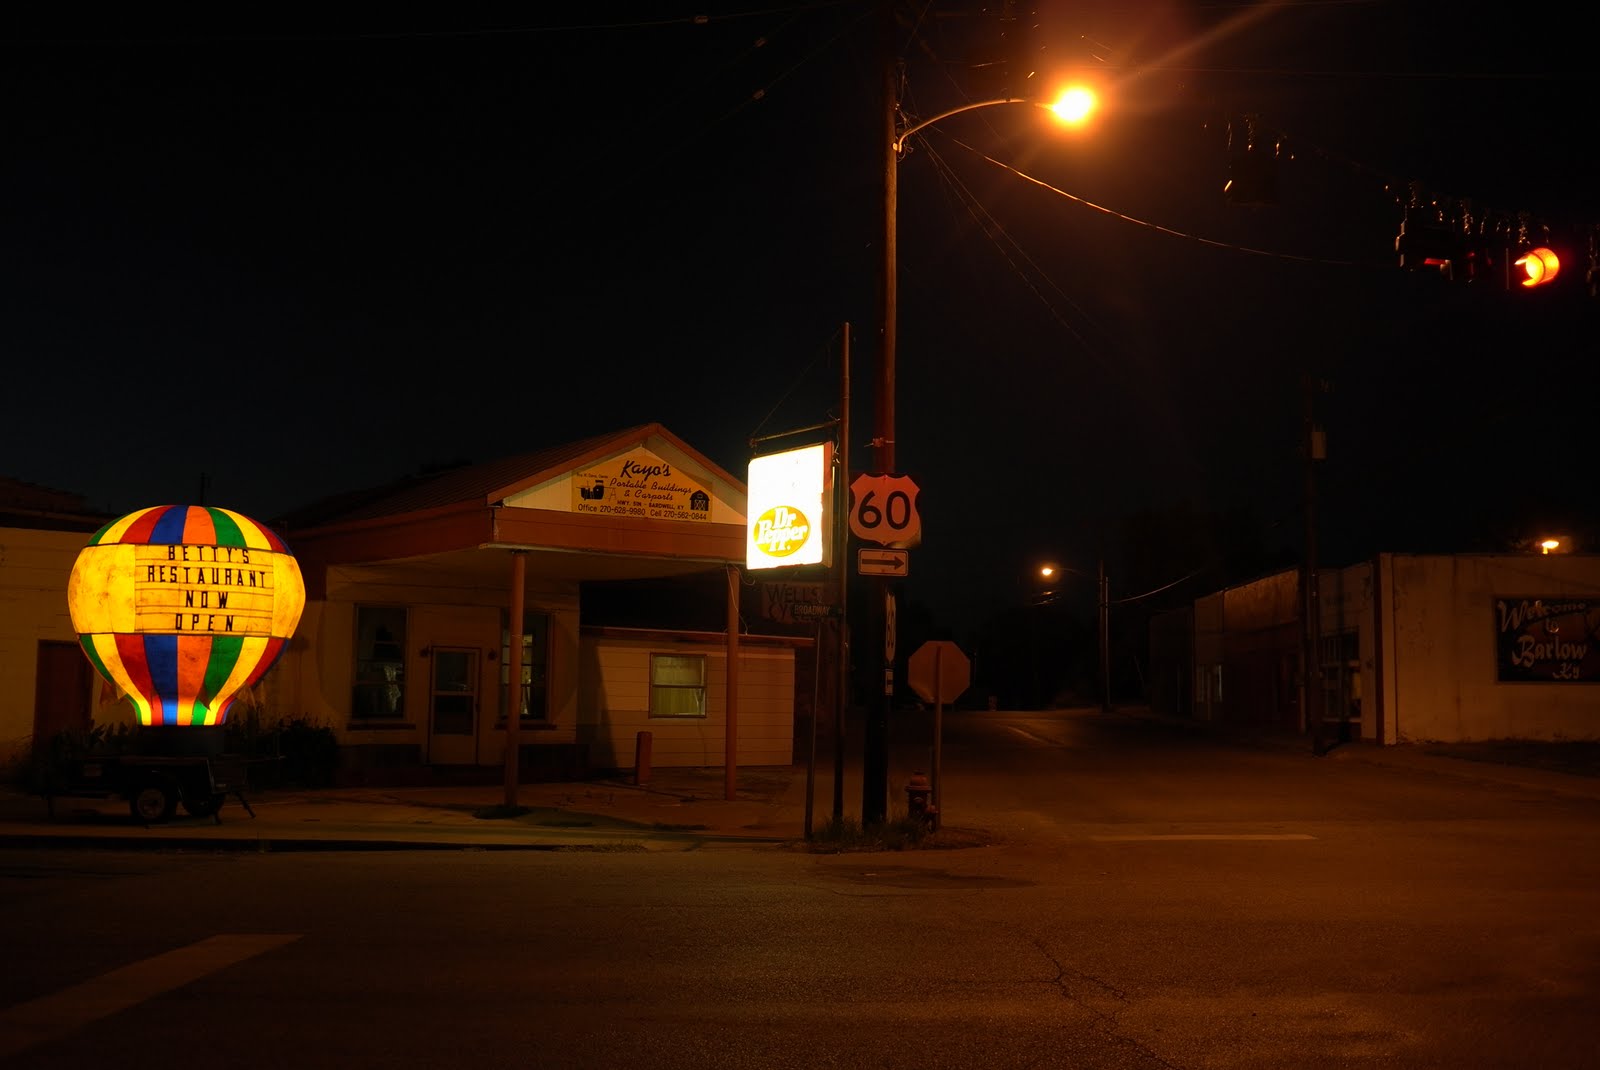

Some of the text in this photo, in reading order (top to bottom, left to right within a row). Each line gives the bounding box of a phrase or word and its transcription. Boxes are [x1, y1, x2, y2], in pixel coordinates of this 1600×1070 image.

[620, 460, 671, 481] Kayo's
[610, 478, 692, 495] Portable Buildings
[634, 490, 673, 501] Carports
[578, 503, 707, 521] Office 270-628-9980 Cell 270-562-0844
[772, 507, 797, 529] Dr
[858, 490, 911, 530] 60
[756, 519, 808, 552] Pepper
[167, 545, 250, 564] BETTY'S
[147, 565, 266, 588] RESTAURANT
[184, 591, 230, 609] NOW
[794, 604, 830, 615] BROADWAY
[175, 613, 234, 632] OPEN
[1497, 599, 1586, 633] Welcome
[1511, 635, 1587, 668] Barlow
